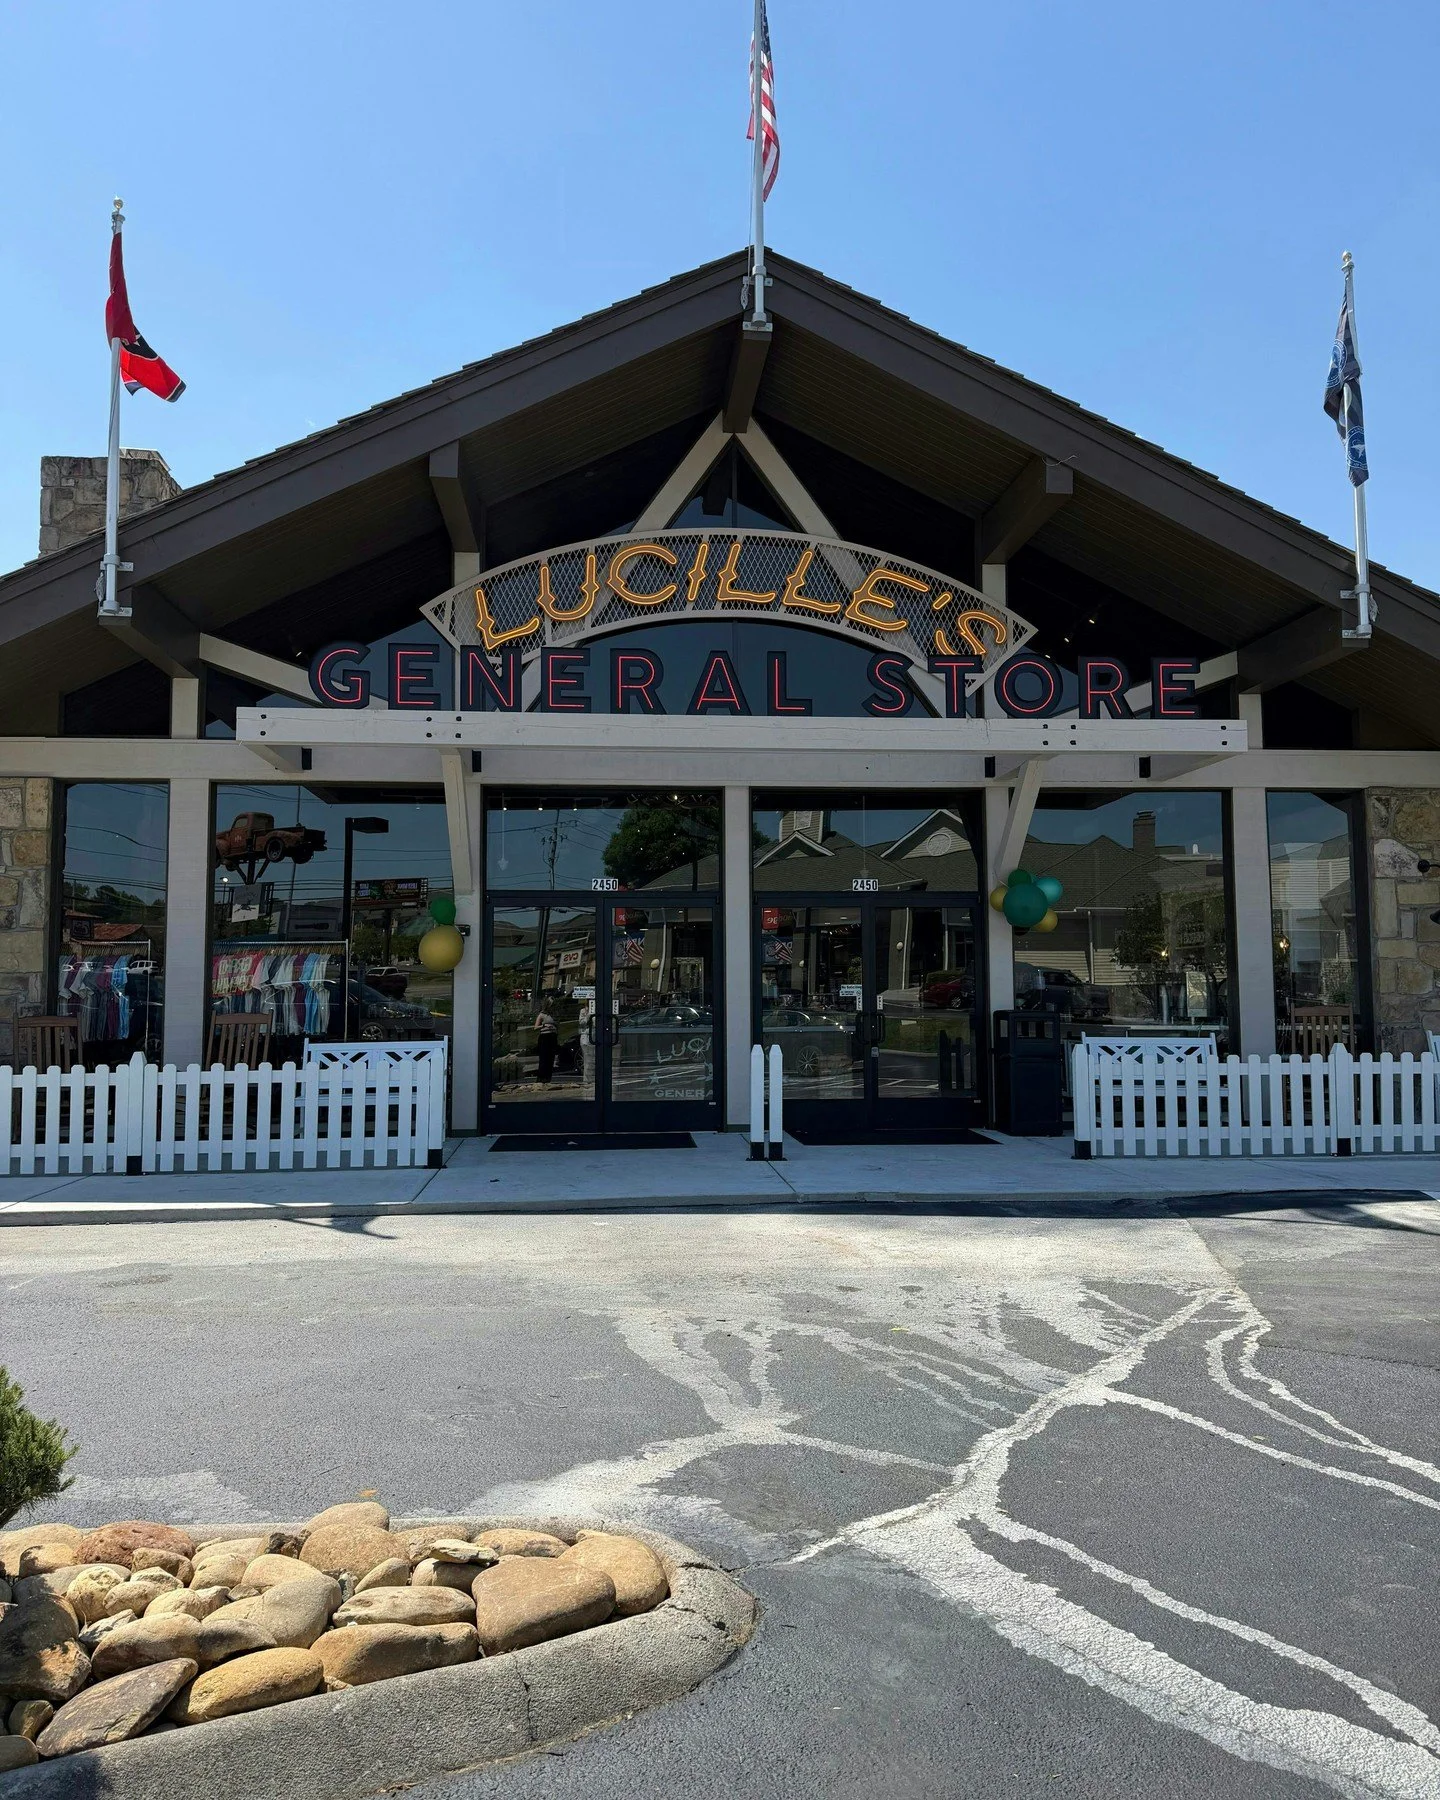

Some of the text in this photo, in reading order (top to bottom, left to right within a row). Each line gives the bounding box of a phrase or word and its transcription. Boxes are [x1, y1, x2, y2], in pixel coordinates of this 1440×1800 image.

[475, 541, 1007, 655] LUCILLE'S
[308, 640, 1201, 719] GENERAL STORE
[592, 878, 618, 891] 2450
[853, 879, 878, 891] 2450
